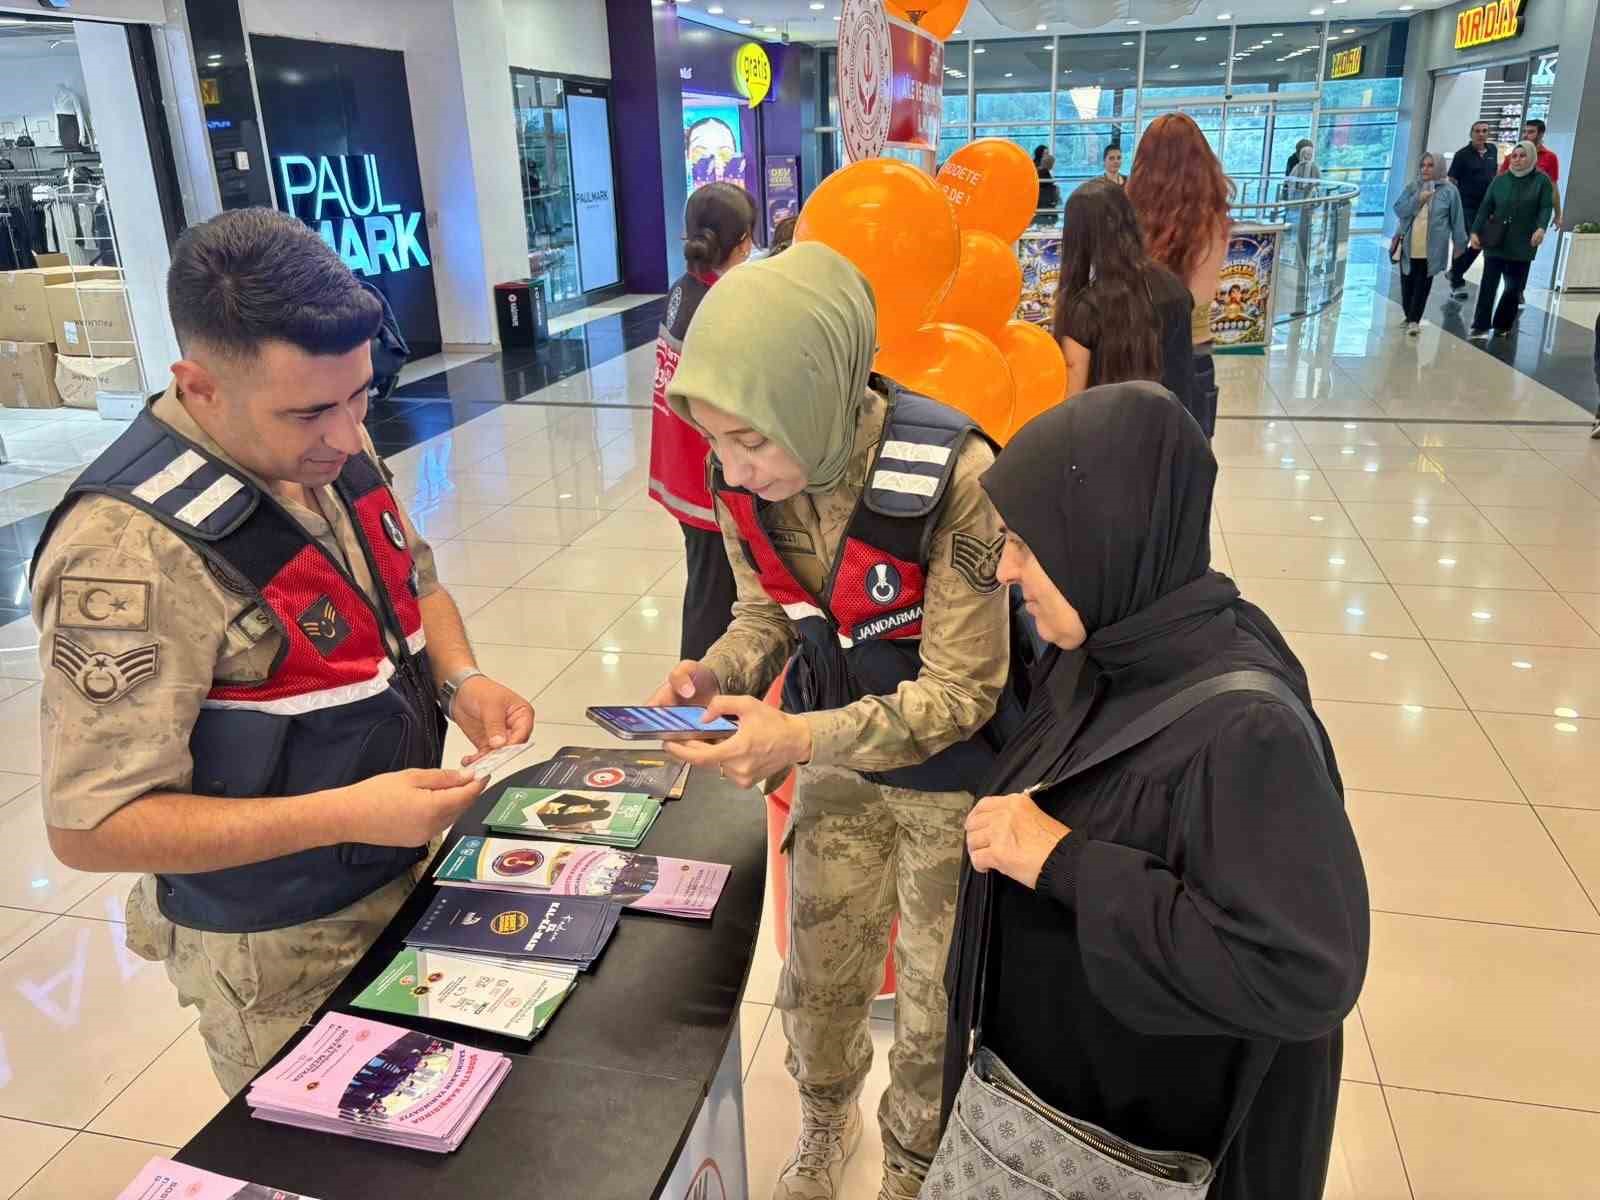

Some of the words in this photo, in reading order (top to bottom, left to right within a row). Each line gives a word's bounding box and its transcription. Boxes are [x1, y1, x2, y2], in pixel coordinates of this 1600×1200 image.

[743, 52, 768, 83] gratis
[280, 154, 401, 219] PAUL
[857, 606, 925, 640] JANDARMA
